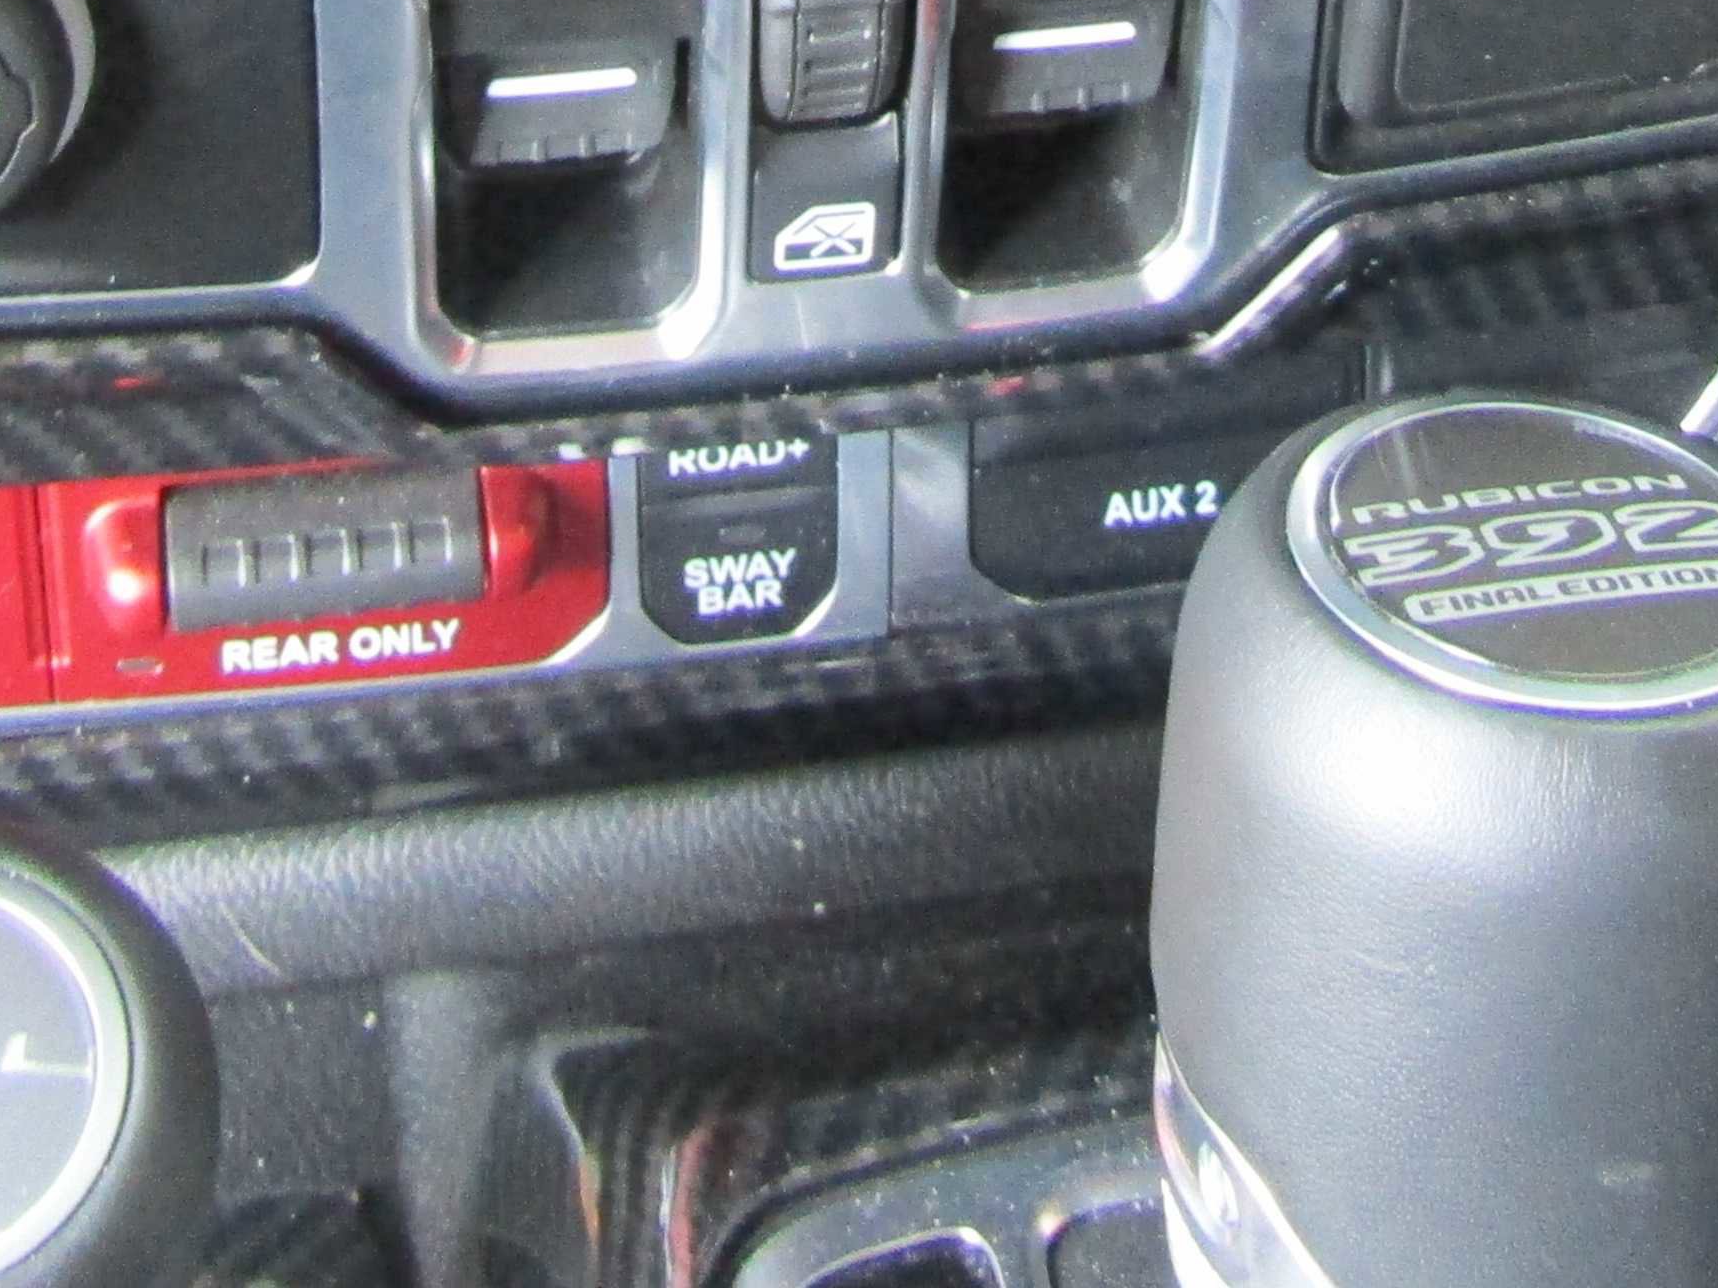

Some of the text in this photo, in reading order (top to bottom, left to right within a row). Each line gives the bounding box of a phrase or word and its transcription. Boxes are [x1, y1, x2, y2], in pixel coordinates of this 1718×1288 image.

[1105, 480, 1219, 527] AUX 2
[1351, 473, 1689, 525] RUBICON
[684, 546, 797, 590] SWAY
[696, 581, 784, 617] BAR
[1418, 577, 1558, 619] FINAL
[221, 617, 460, 674] REAR ONLY
